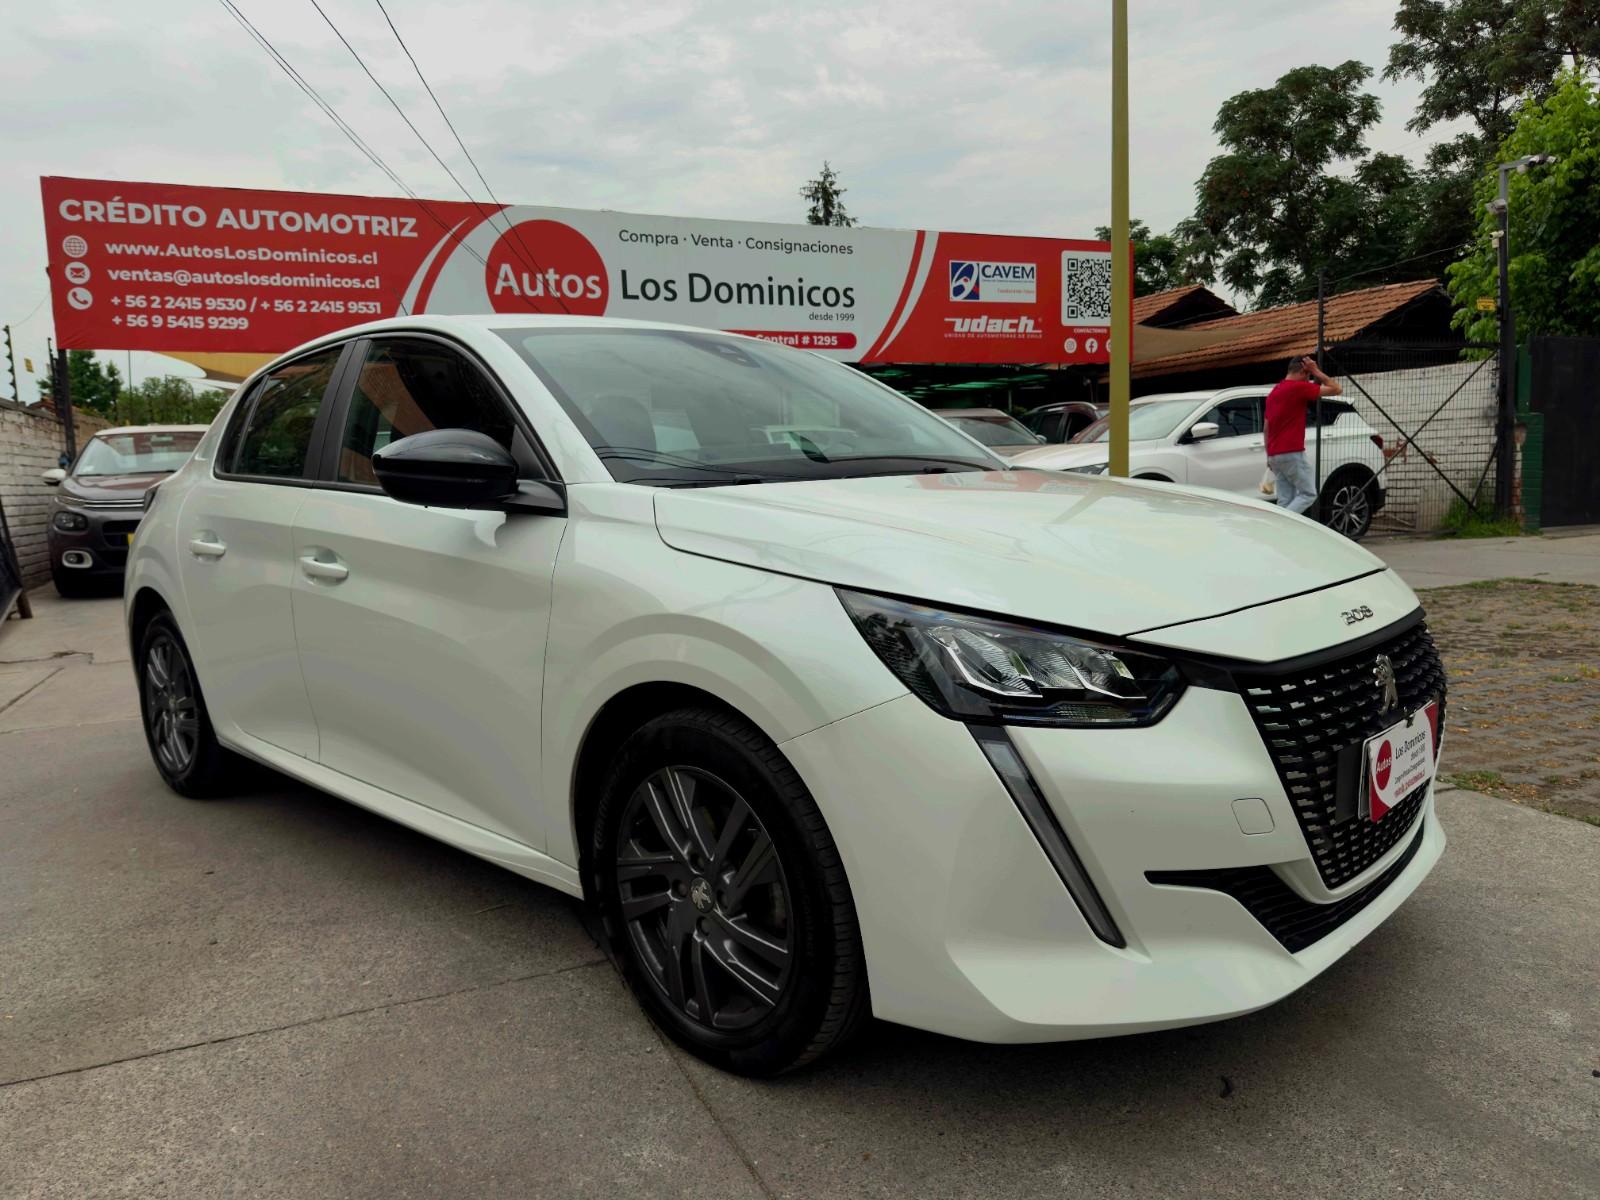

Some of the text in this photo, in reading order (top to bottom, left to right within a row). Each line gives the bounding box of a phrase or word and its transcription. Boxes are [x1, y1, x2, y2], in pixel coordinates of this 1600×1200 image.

[58, 196, 418, 238] CRÉDITO AUTOMOTRIZ
[618, 229, 680, 247] Compra
[691, 233, 734, 249] Venta
[745, 237, 854, 255] Consignaciones
[105, 242, 378, 265] www.AutosLosDominicos.cl
[107, 268, 380, 290] ventas@autoslosdominicos.cl
[494, 263, 602, 299] Autos
[981, 264, 1035, 280] CAVEM
[620, 269, 855, 308] Los Dominicos
[125, 295, 148, 308] 56
[150, 295, 162, 309] 2
[164, 296, 203, 310] 2415
[205, 297, 247, 311] 9530
[273, 300, 295, 312] 56
[296, 300, 308, 313] 2
[309, 300, 345, 314] 2415
[347, 301, 381, 314] 9531
[126, 314, 149, 327] 56
[151, 315, 163, 328] 9
[166, 316, 205, 329] 5415
[207, 317, 249, 330] 9299
[808, 312, 855, 321] desde 1999
[944, 315, 1042, 333] udach
[801, 335, 810, 345] #
[813, 335, 838, 346] 1295
[1395, 746, 1404, 760] Los
